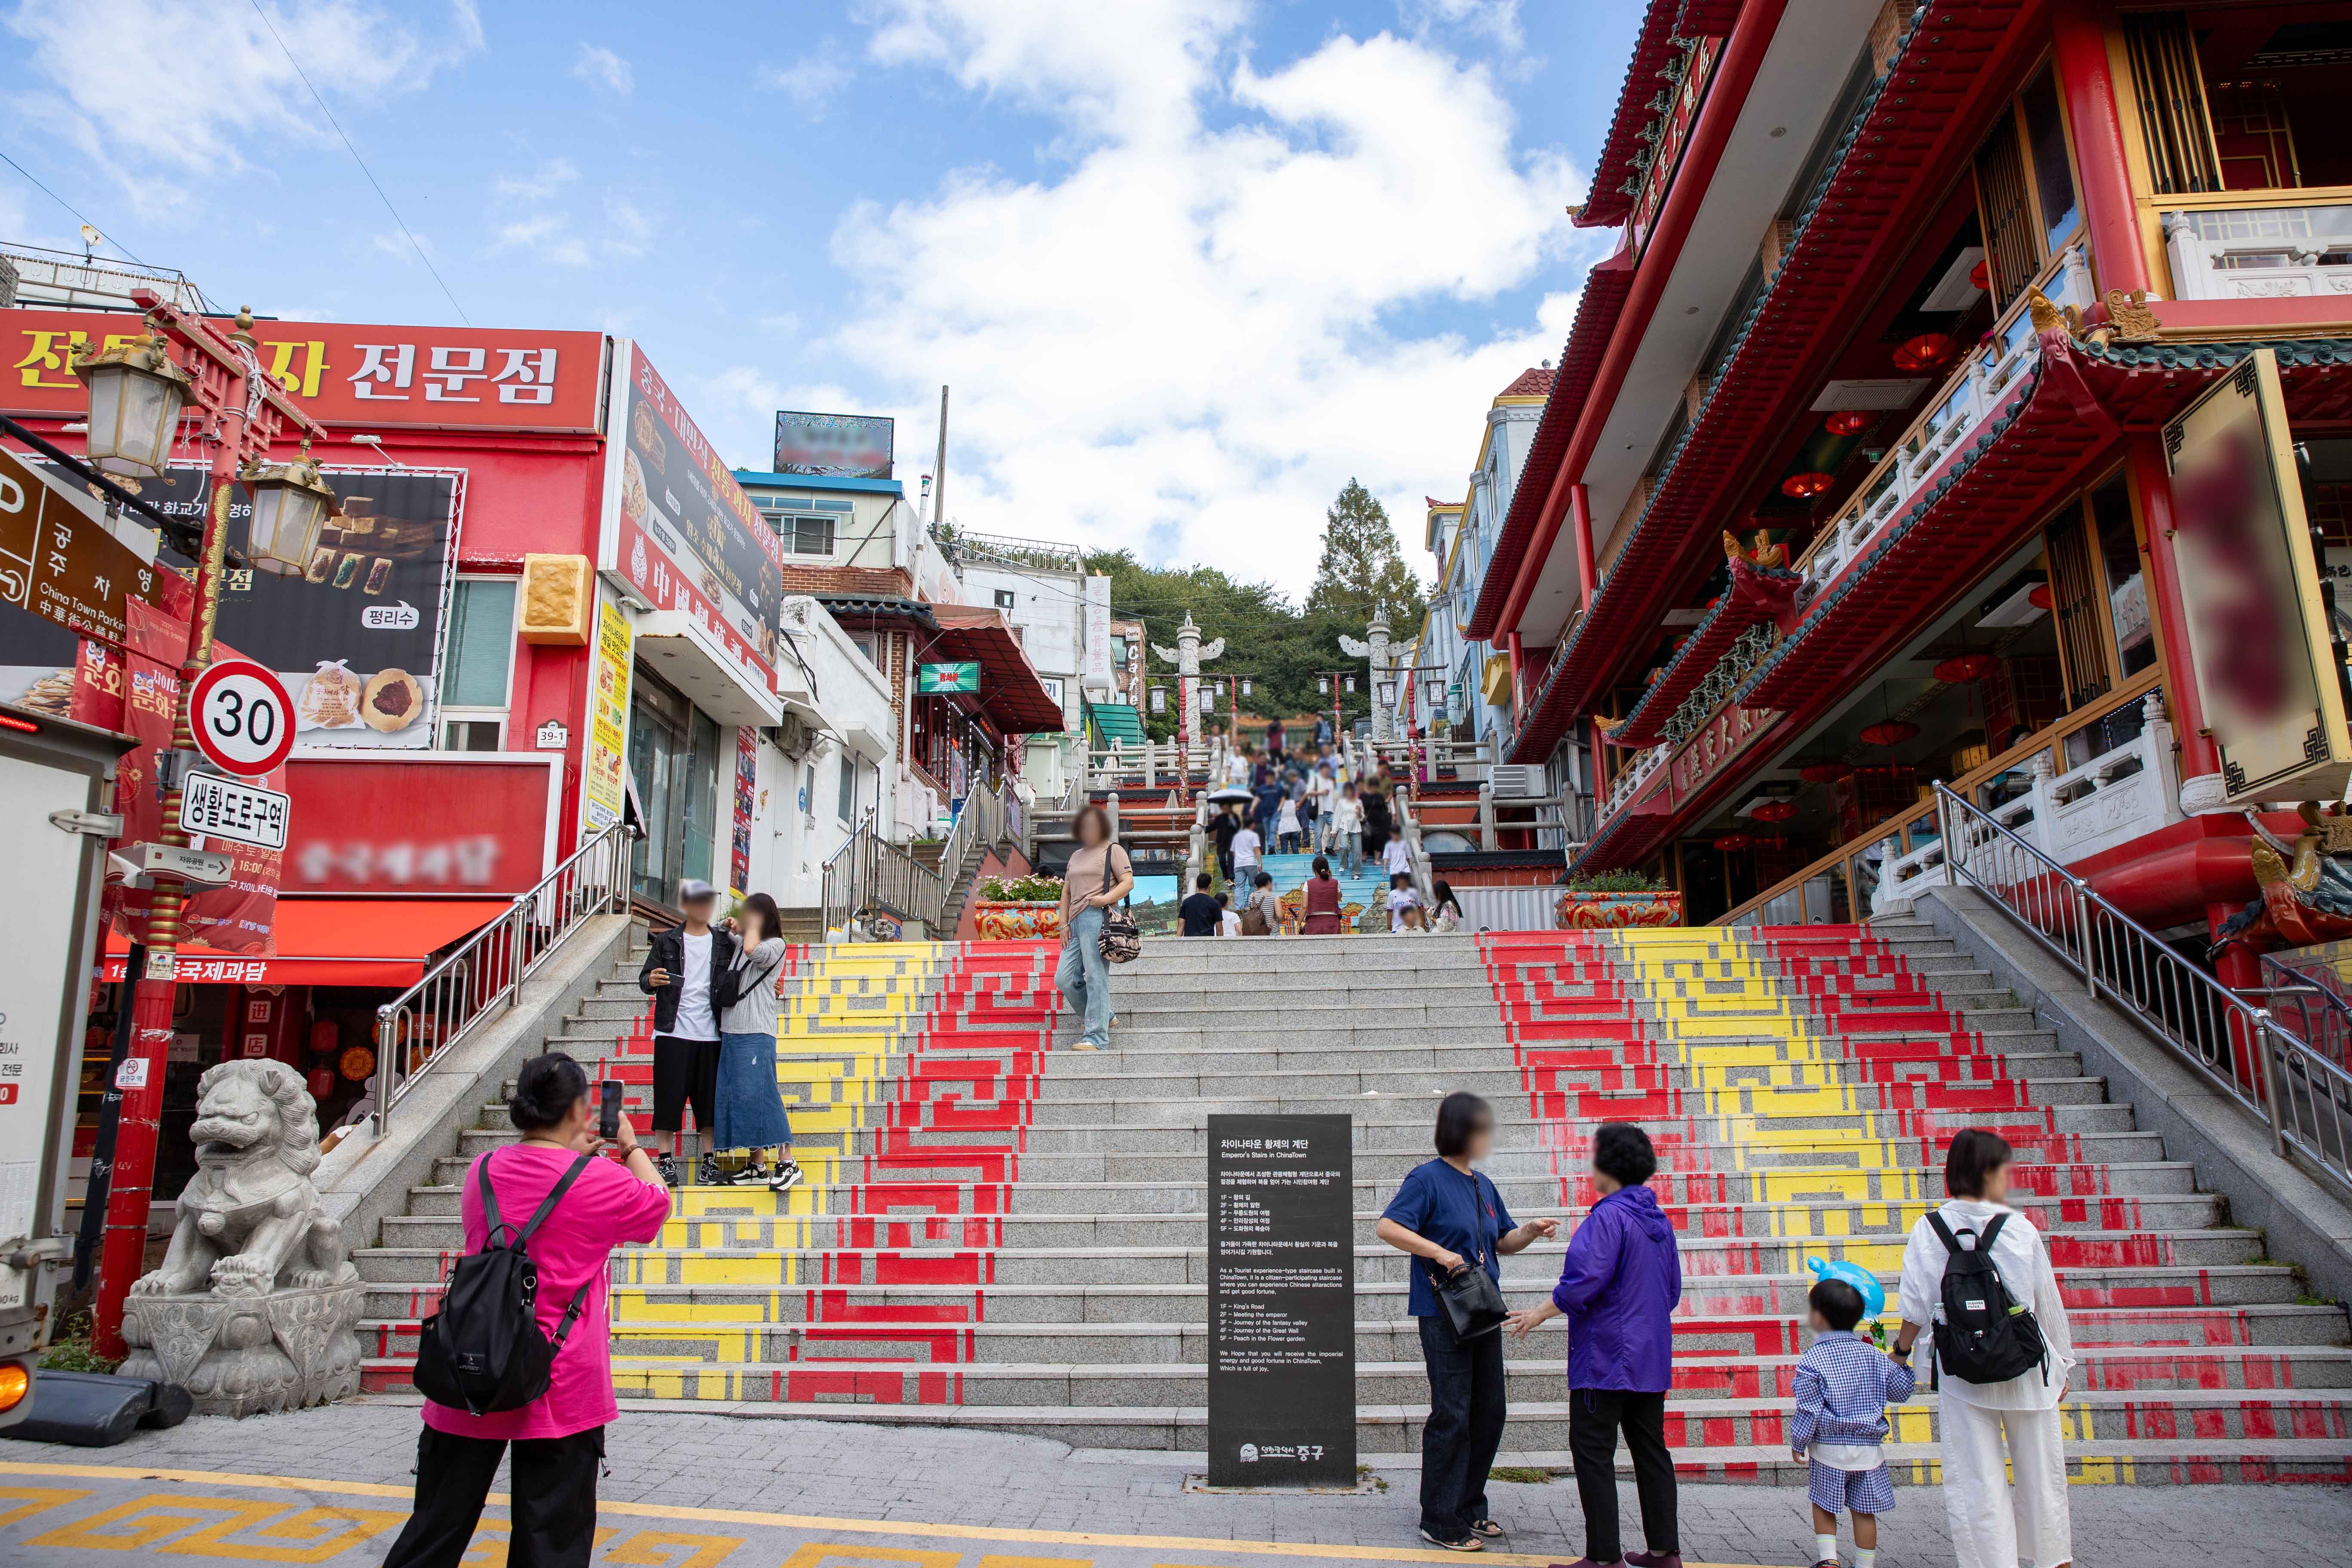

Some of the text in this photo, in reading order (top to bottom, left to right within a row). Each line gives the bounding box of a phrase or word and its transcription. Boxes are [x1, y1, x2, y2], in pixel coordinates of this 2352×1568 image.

[347, 344, 557, 404] 전문점
[163, 501, 207, 516] 화교가
[711, 453, 730, 499] 전통
[733, 484, 752, 528] 과자
[753, 512, 779, 564] 전문점
[726, 566, 742, 597] 전문점
[40, 582, 126, 633] China Town Parkin
[369, 610, 413, 626] 펑리수
[602, 632, 624, 660] 제일 맛있는
[1128, 645, 1139, 705] Cafe
[214, 689, 275, 747] 30
[541, 732, 564, 740] 39-1
[191, 783, 282, 840] 생활도로구역
[179, 856, 205, 867] 자유공원
[239, 860, 263, 874] 16:00
[239, 881, 273, 896] 차이나타운
[1, 1064, 22, 1076] 전문
[1221, 1139, 1308, 1149] 차이나타운 황제의 계단
[1296, 1446, 1324, 1461] 중구
